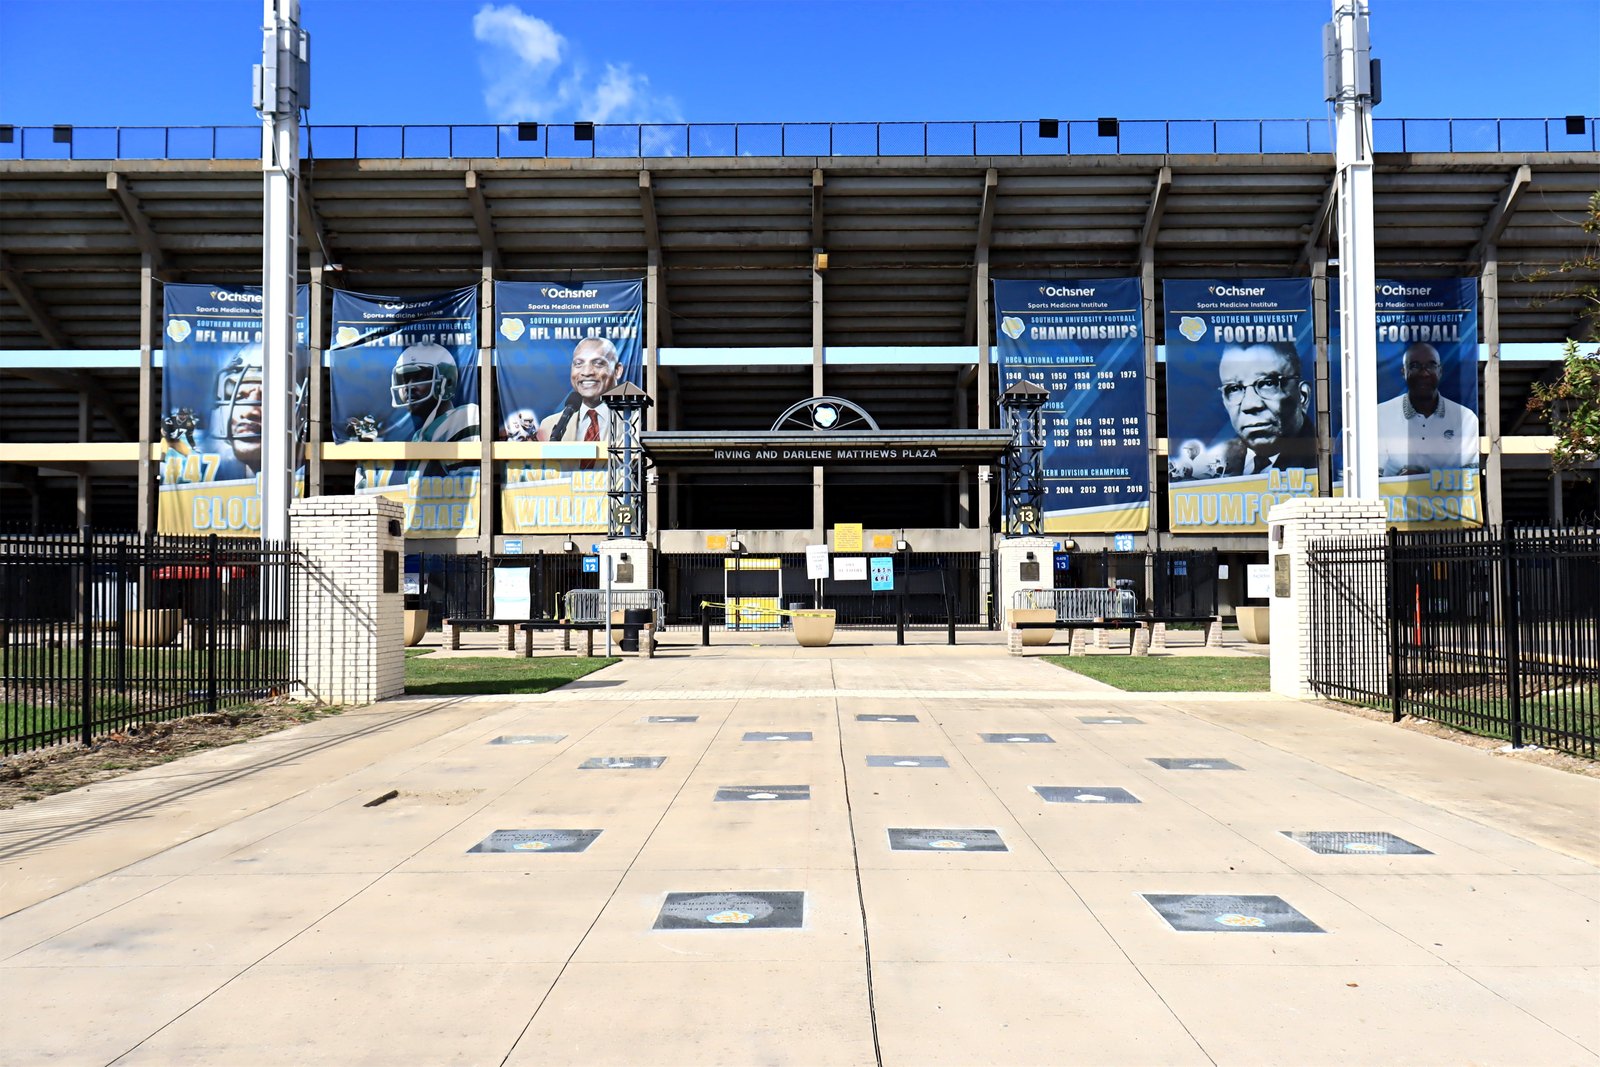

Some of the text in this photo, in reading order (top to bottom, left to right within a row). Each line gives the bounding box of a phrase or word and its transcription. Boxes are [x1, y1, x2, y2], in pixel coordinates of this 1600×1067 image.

[548, 288, 598, 298] Ochsner
[1046, 287, 1095, 297] Ochsner
[1216, 286, 1265, 296] Ochsner
[1382, 285, 1431, 295] Ochsner
[217, 291, 263, 302] Ochsne
[1211, 315, 1298, 324] SOUTHERN UNIVERSITY
[195, 330, 217, 342] NFL
[222, 331, 250, 343] HALL
[530, 326, 637, 339] NFL HALL OF FAME
[1031, 325, 1138, 340] CHAMPIONSHIPS
[1214, 325, 1297, 342] FOOTBALL
[1379, 325, 1461, 342] FOOTBALL
[390, 334, 418, 346] HALL
[422, 334, 436, 345] OF
[440, 333, 472, 345] FAME
[1024, 356, 1053, 364] NATIONAL
[1051, 372, 1067, 380] 1950
[1076, 439, 1092, 447] 1998
[1123, 438, 1140, 446] 2003
[714, 449, 937, 459] IRVING AND DARLENE MATTHEWS PLAZA
[165, 454, 220, 483] #47
[1430, 468, 1474, 491] PETE
[193, 496, 262, 530] BLOU
[516, 497, 609, 526] WILLIA
[1175, 492, 1308, 525] MUMFO
[618, 513, 631, 523] 12
[1020, 511, 1034, 522] 13
[1116, 540, 1132, 551] 13
